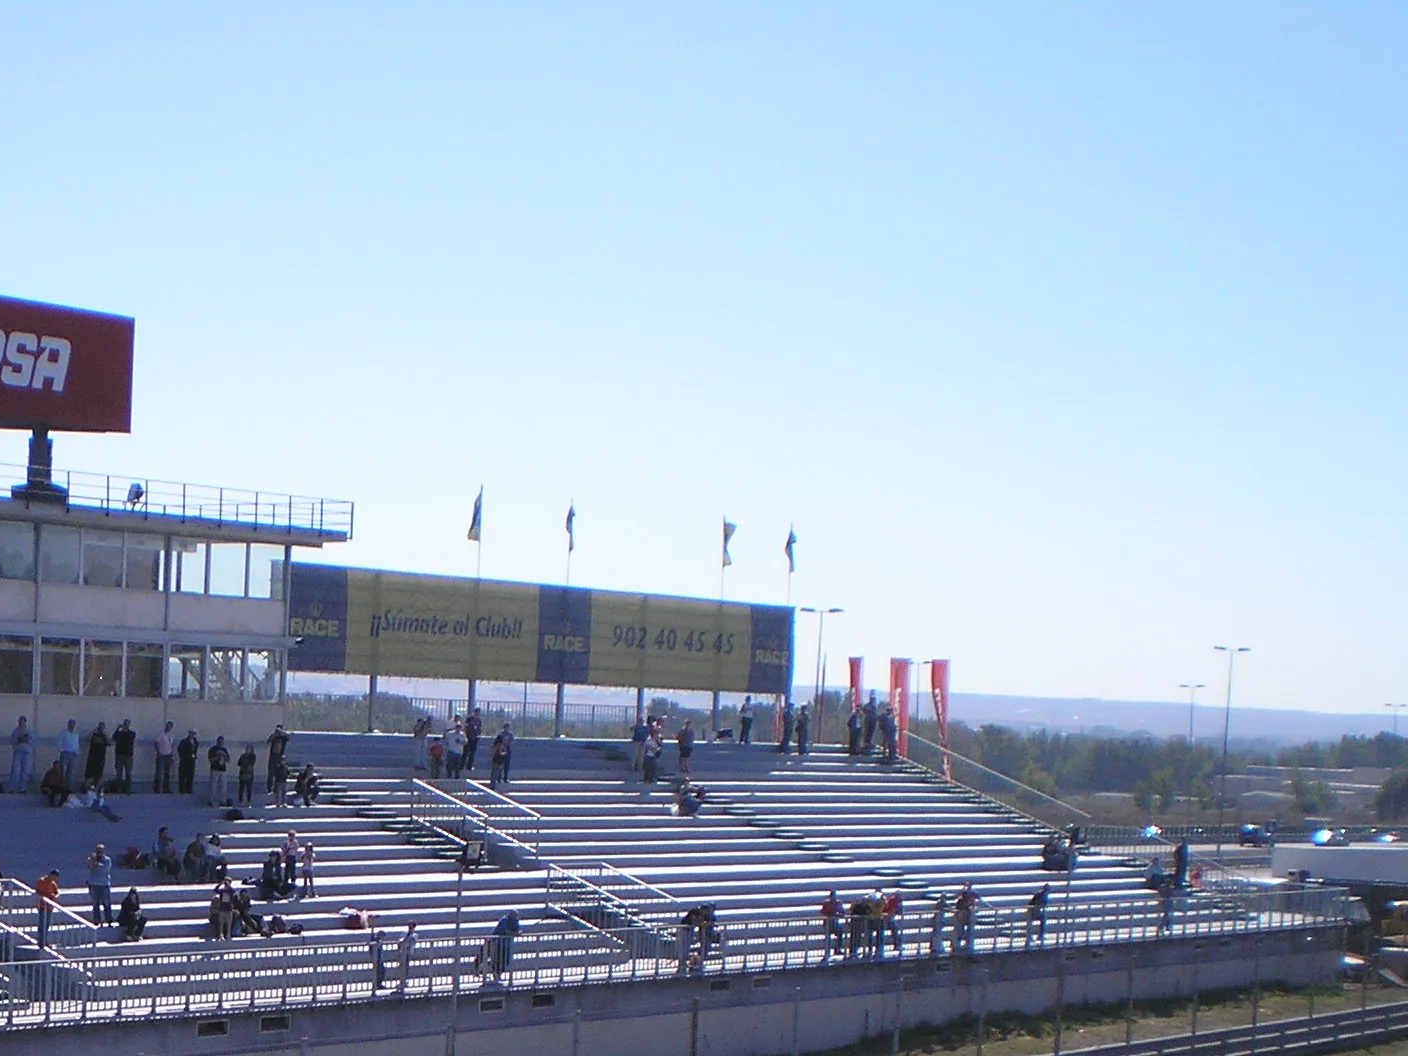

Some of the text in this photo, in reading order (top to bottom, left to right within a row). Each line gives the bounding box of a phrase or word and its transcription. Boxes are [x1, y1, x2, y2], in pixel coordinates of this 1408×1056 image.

[290, 617, 340, 637] RACE
[453, 614, 470, 636] al
[543, 634, 588, 653] RACE
[612, 625, 735, 655] 902 40 45 45
[755, 649, 789, 666] RACE
